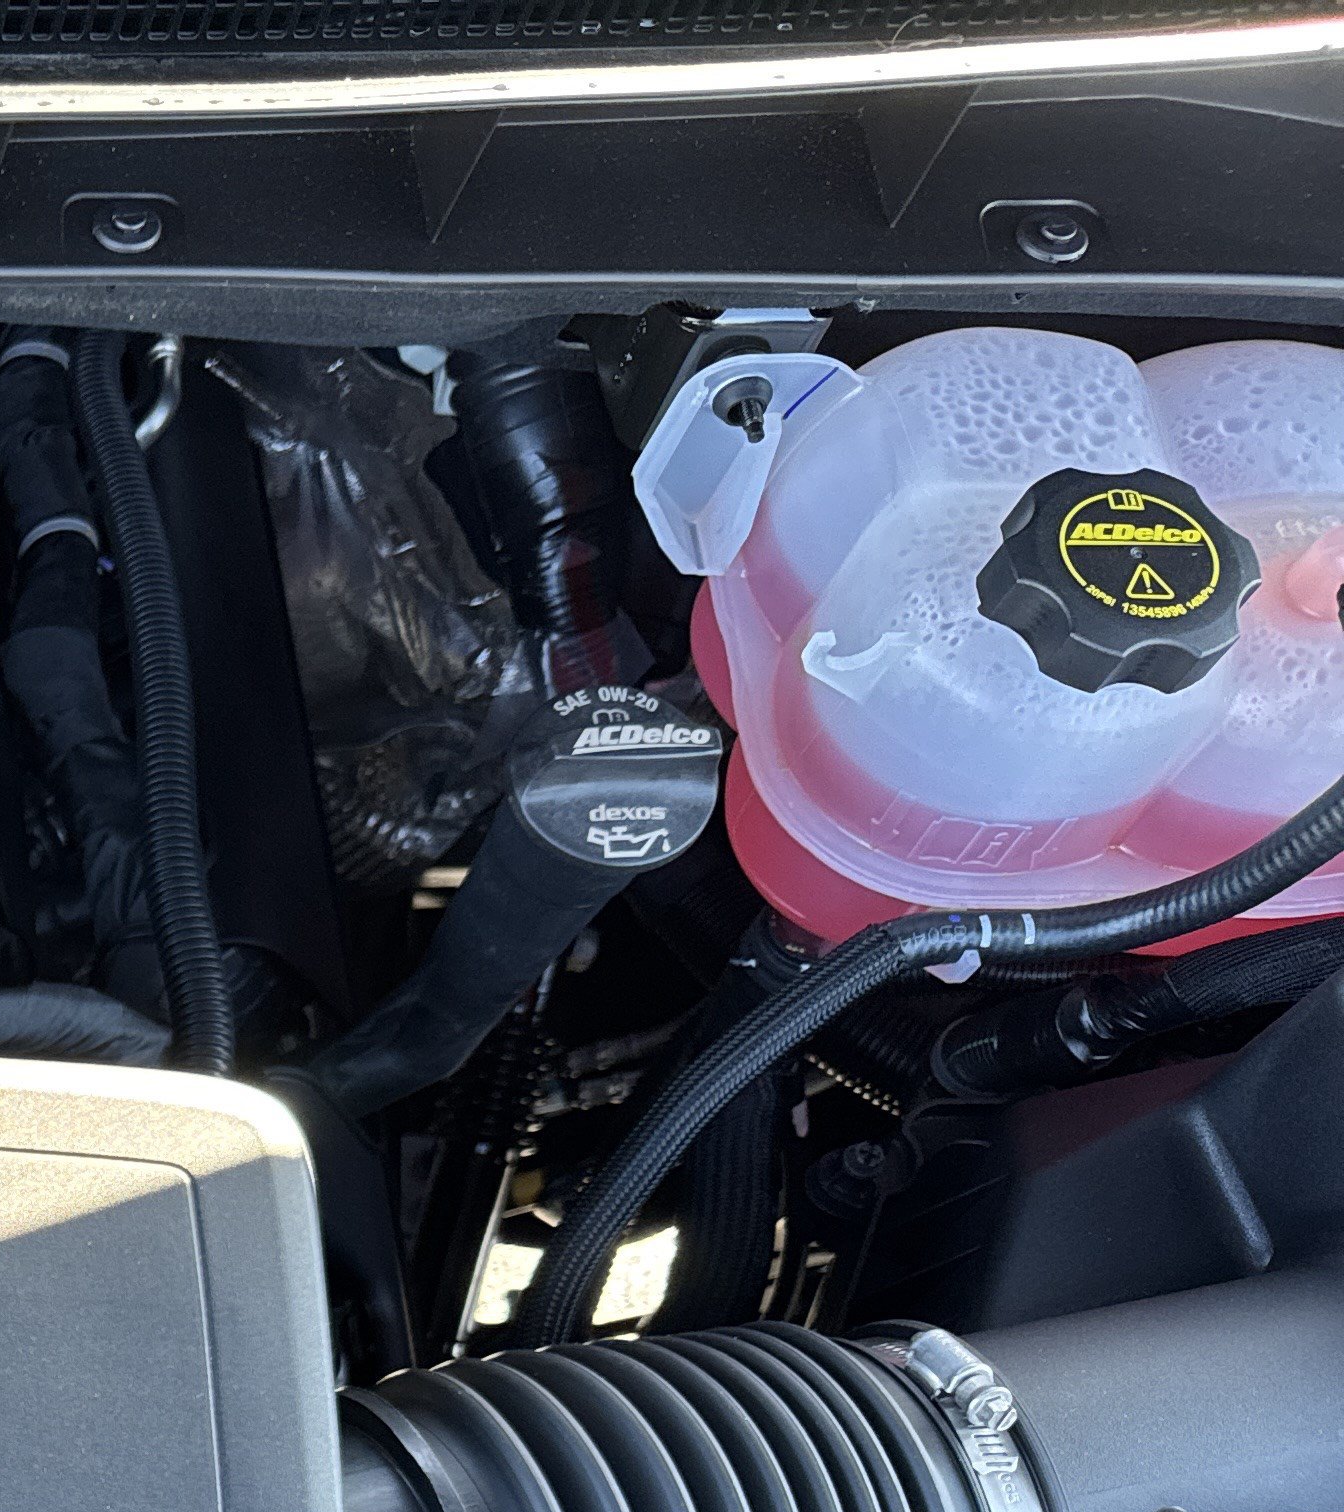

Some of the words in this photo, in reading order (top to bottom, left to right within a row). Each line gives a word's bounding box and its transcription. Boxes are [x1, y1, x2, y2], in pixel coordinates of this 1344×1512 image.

[1070, 522, 1202, 544] ACDelco
[553, 690, 591, 717] SAE
[598, 685, 659, 713] 0W-20
[573, 723, 711, 749] ACDelco
[589, 803, 667, 822] dexos
